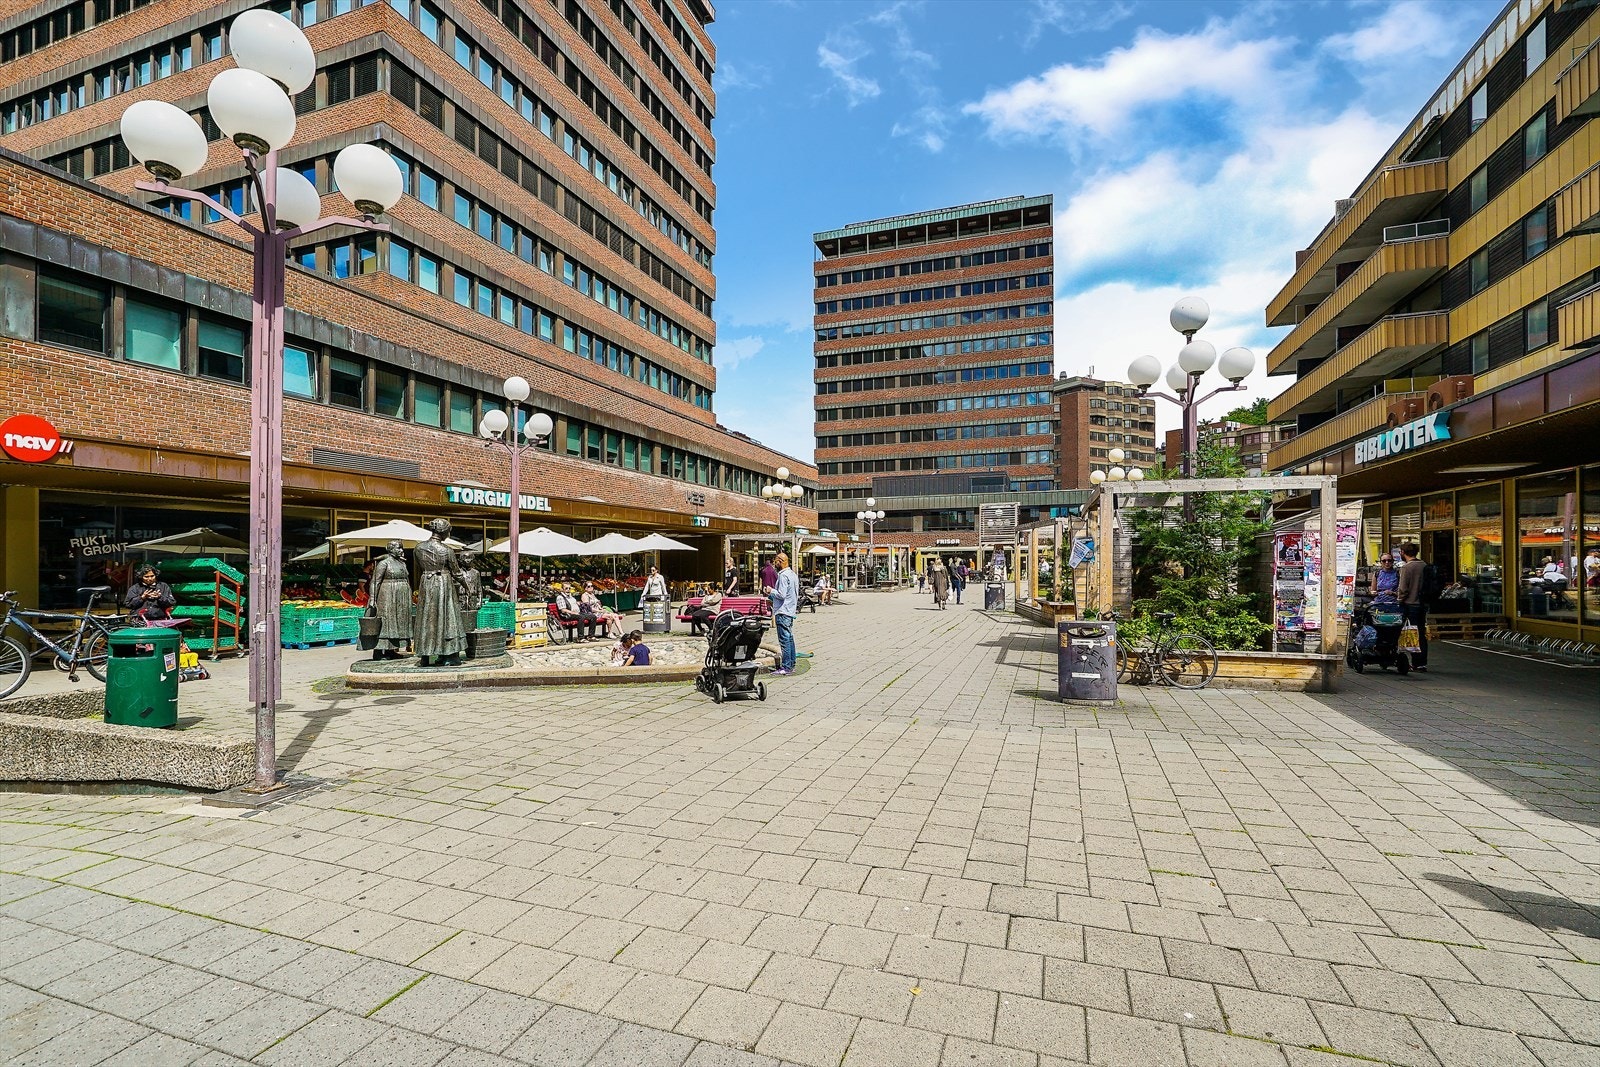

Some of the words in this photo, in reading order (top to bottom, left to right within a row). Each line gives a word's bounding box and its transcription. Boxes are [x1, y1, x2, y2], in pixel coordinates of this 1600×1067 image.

[4, 433, 57, 451] nav
[1355, 412, 1447, 465] BIBLIOTEK
[83, 543, 128, 556] GRØNT
